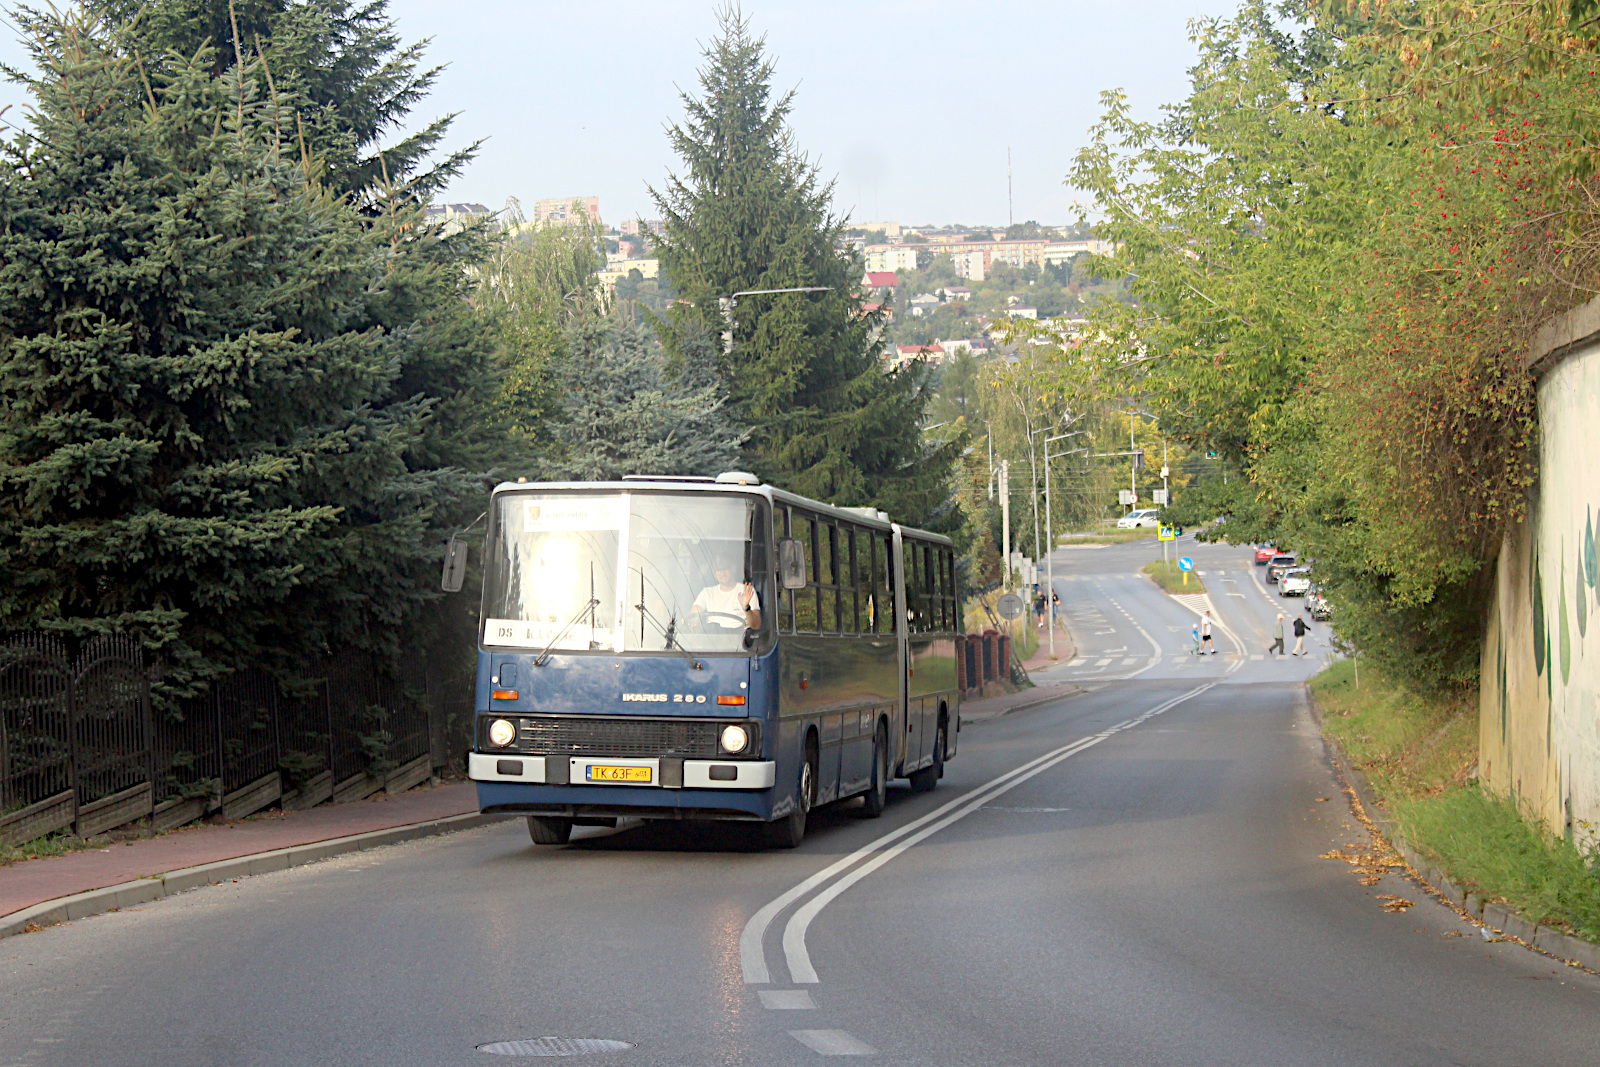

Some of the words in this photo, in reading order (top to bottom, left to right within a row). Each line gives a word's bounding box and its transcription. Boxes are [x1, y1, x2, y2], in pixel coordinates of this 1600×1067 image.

[498, 627, 513, 638] DS
[622, 693, 668, 702] IKARUS
[673, 694, 707, 704] 280
[594, 767, 608, 779] TK
[612, 768, 633, 779] 63F
